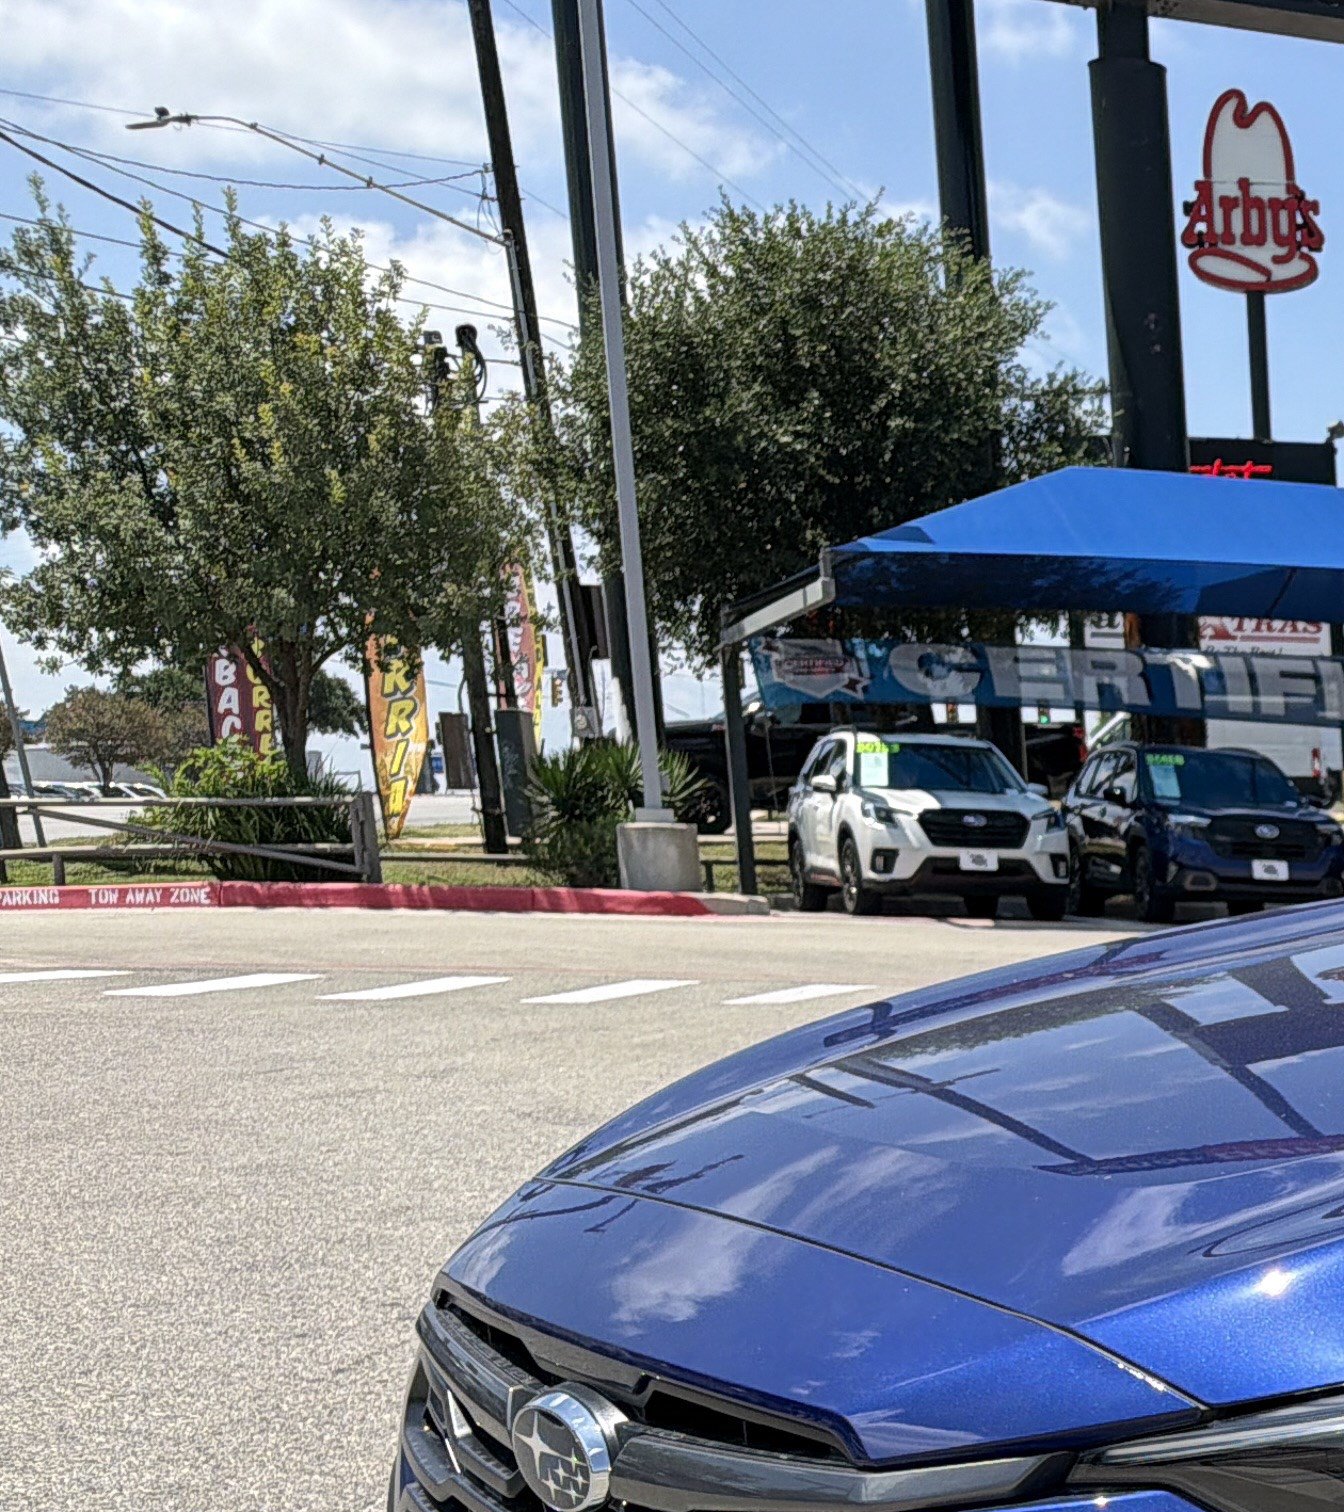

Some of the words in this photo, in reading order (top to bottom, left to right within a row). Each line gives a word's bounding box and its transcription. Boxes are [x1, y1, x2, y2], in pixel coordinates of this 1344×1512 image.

[0, 889, 60, 906] ARKING
[88, 888, 119, 905] TOW
[126, 887, 162, 904] AWAY
[170, 887, 211, 904] ZONE
